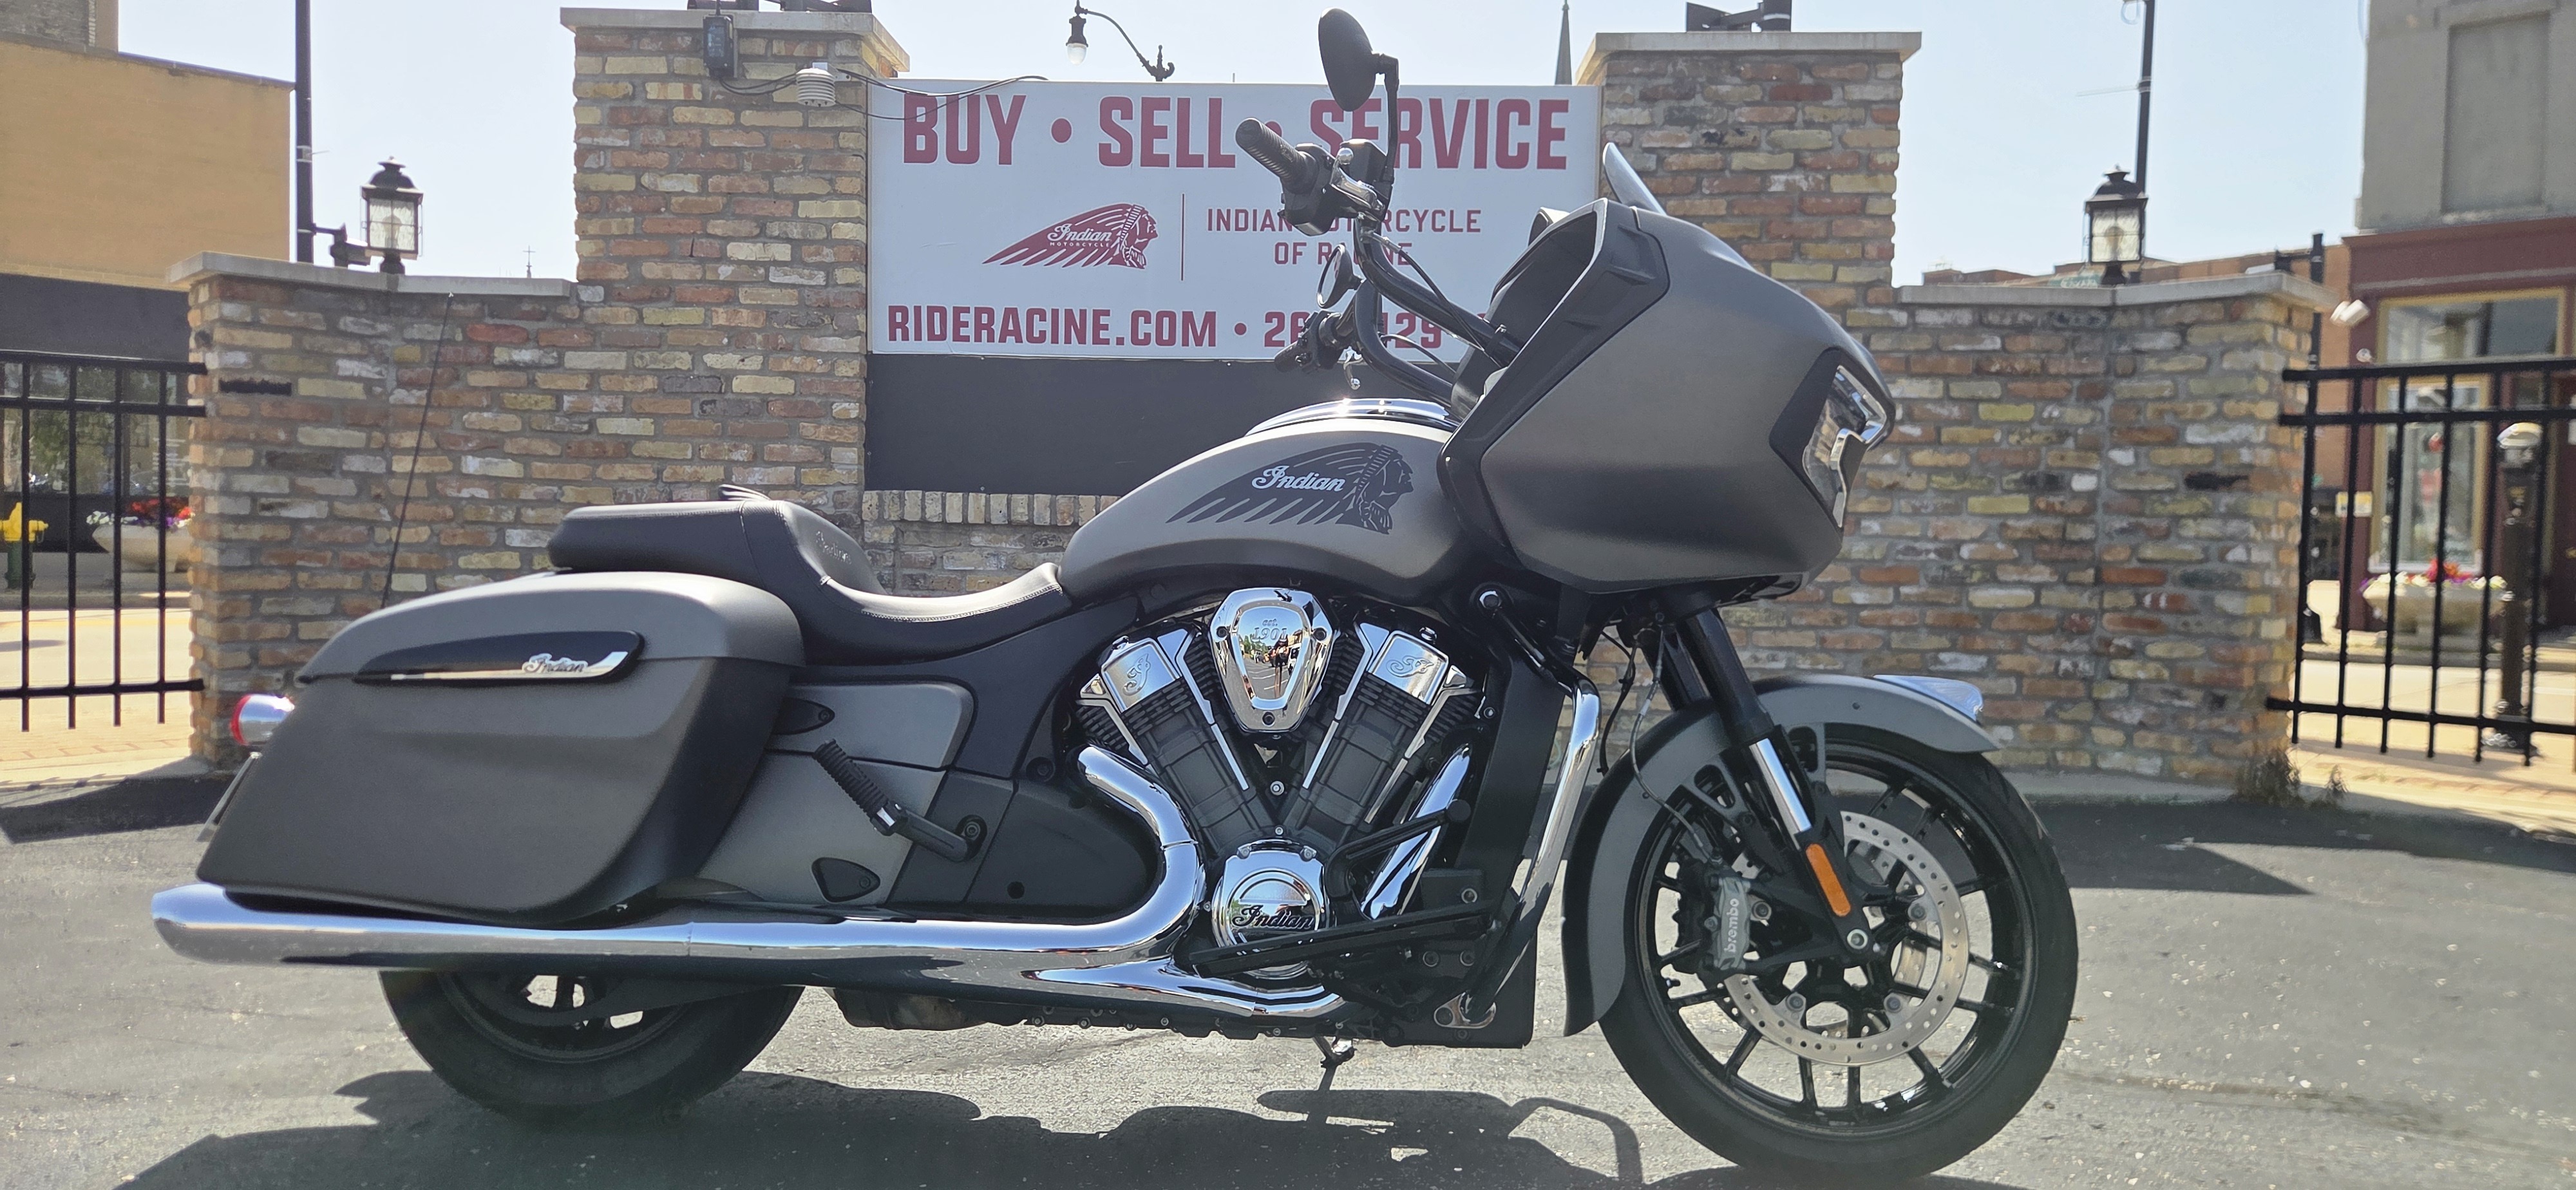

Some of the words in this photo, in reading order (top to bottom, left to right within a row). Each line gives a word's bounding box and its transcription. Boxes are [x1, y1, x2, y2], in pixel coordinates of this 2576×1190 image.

[904, 93, 1027, 165] BUY
[1098, 96, 1236, 168] SELL
[1047, 223, 1112, 242] Indian
[1329, 209, 1481, 233] RCYCLE
[1274, 241, 1307, 265] OF
[887, 305, 1217, 347] RIDERACINE.COM
[1251, 465, 1346, 492] Indian
[1251, 627, 1288, 641] 1901
[522, 653, 589, 674] Indian
[1231, 904, 1314, 930] Indian
[1723, 898, 1739, 952] brembo
